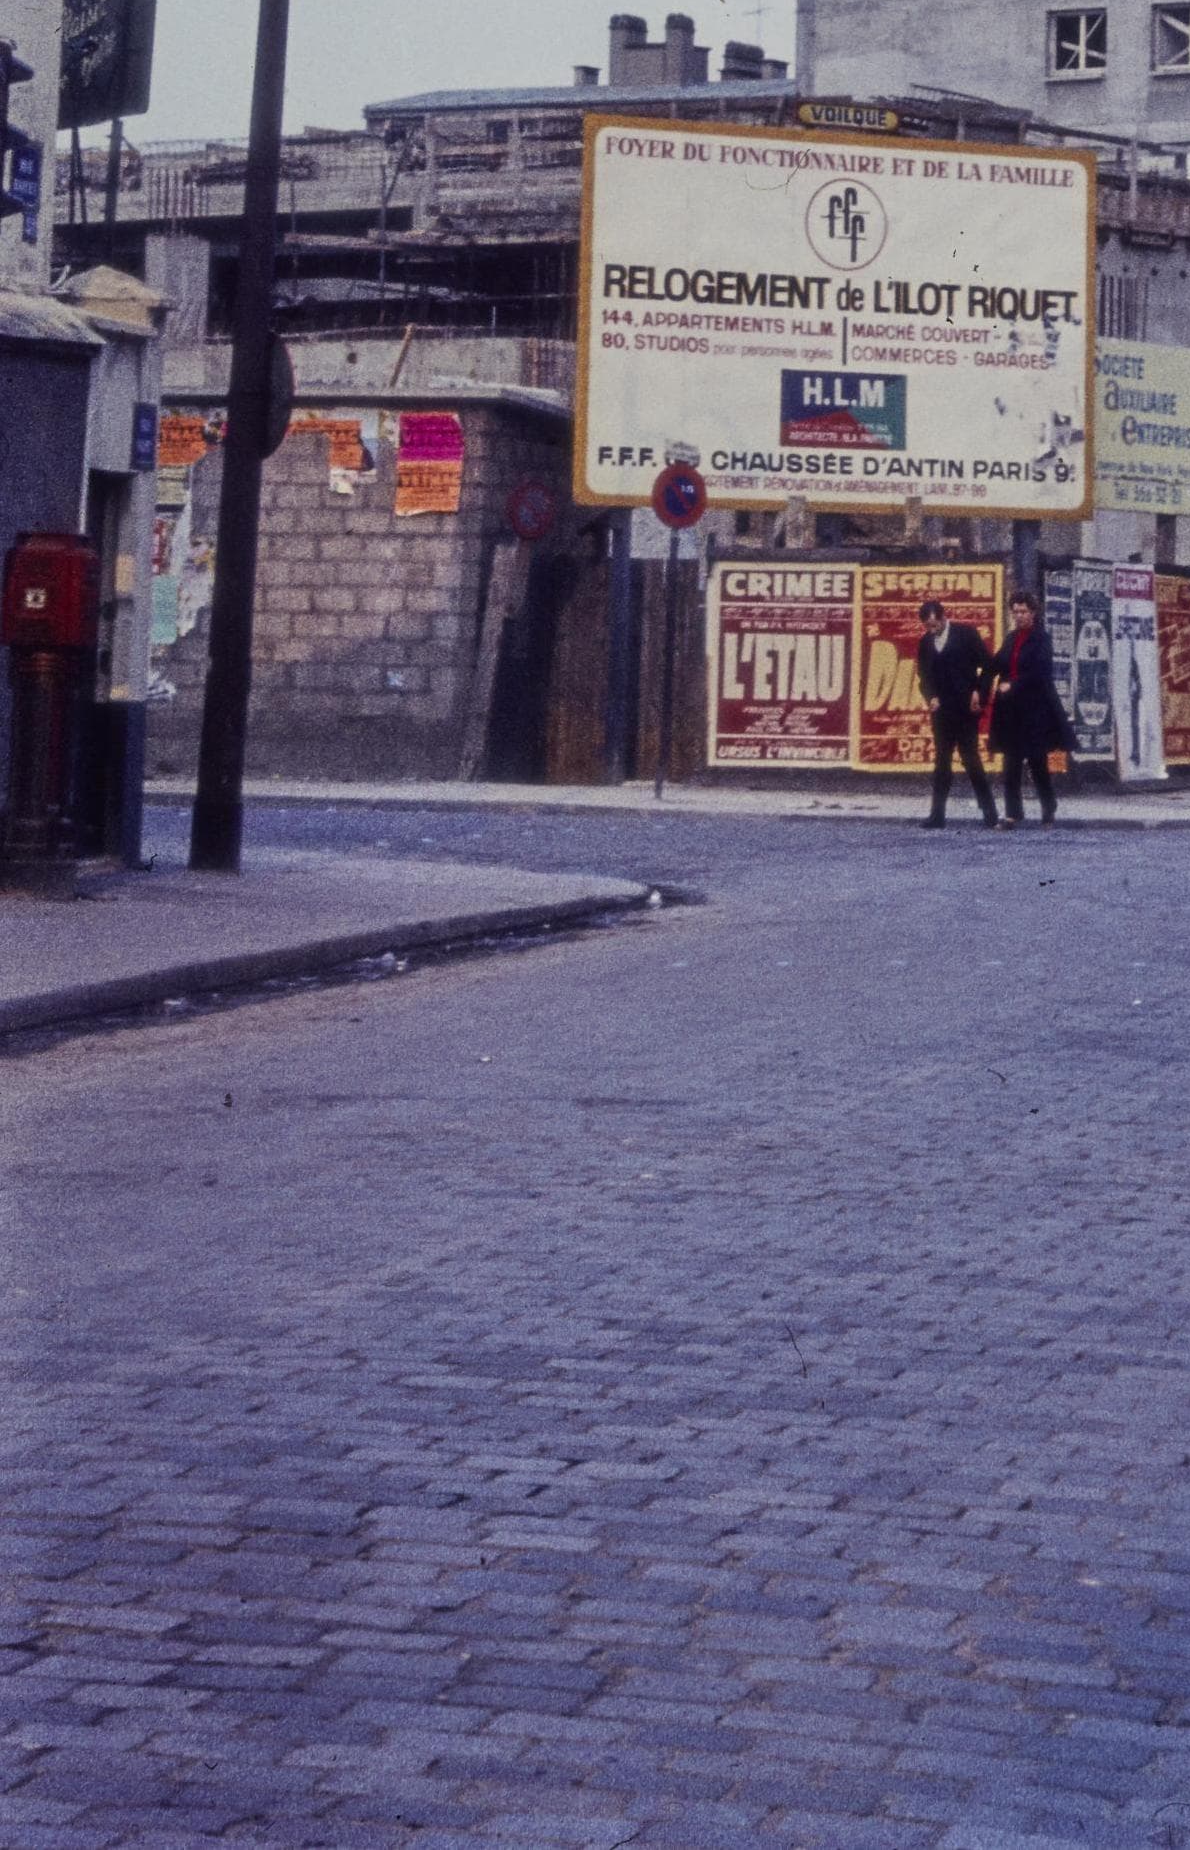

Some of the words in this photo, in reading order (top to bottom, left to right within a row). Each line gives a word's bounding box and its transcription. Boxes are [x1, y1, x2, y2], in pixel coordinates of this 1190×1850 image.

[605, 136, 675, 159] FOYER
[682, 141, 712, 162] DU
[720, 144, 884, 174] FONCTIONNAIRE
[892, 158, 914, 177] ET
[923, 160, 949, 178] DE
[957, 162, 982, 181] LA
[990, 164, 1074, 188] FAMILLE
[603, 264, 831, 310] RELOGEMENT
[836, 278, 864, 311] de
[874, 280, 961, 316] L'ILOT
[968, 285, 1078, 322] RIQUET
[642, 312, 785, 335] APPARTEMENTS
[851, 322, 915, 341] MARCHÉ
[921, 326, 991, 344] COUVERT
[634, 333, 709, 354] STUDIOS
[852, 345, 957, 366] COMMERCES
[973, 350, 1050, 370] GARAGES
[803, 377, 885, 407] H.L.M
[598, 446, 657, 467] F.F.F.
[711, 449, 853, 475] CHAUSSÉE
[863, 456, 964, 478] D'ANTIN
[973, 459, 1046, 482] PARIS
[725, 572, 850, 598] CRIMÉE
[863, 573, 994, 598] SECRETAN
[722, 633, 846, 703] L'ETAU
